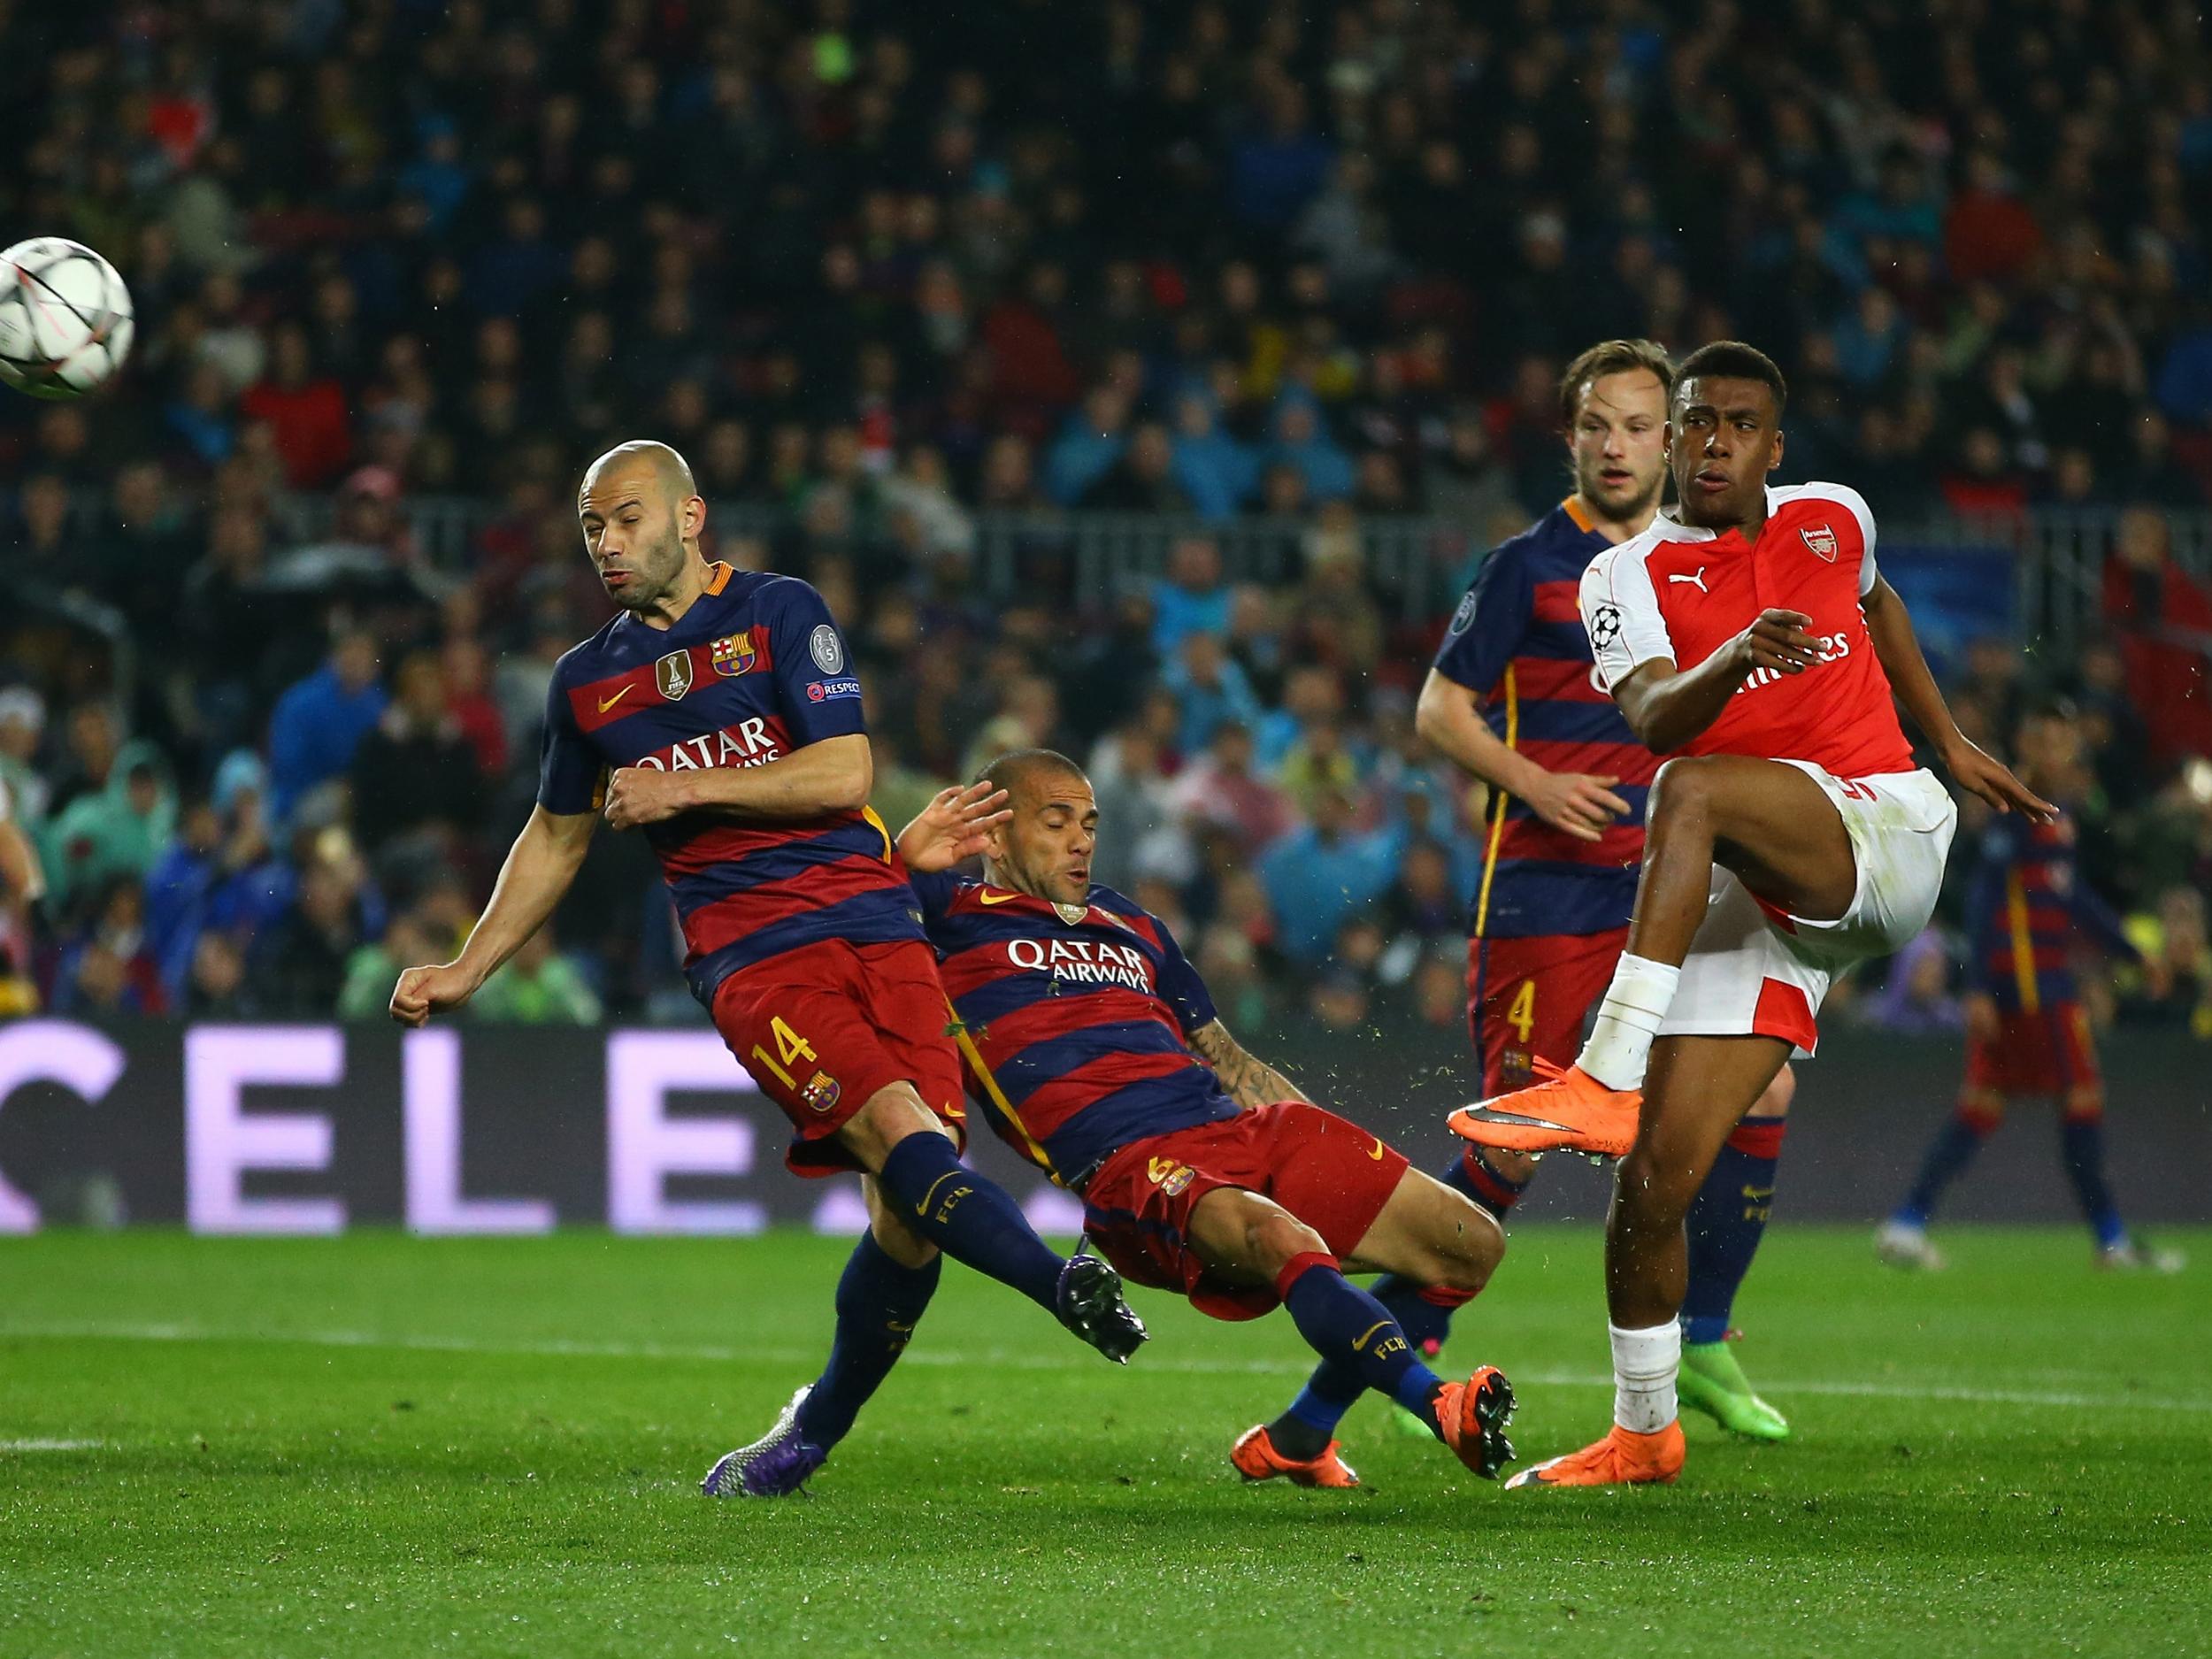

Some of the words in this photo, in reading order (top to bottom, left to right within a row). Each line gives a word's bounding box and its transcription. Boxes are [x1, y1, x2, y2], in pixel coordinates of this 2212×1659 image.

[826, 648, 834, 662] 5
[668, 680, 685, 691] FIFA
[824, 682, 861, 695] RESPEC
[1008, 939, 1146, 976] QATAR
[1054, 961, 1149, 995] AIRWAYS
[1508, 980, 1535, 1043] 4
[751, 1016, 818, 1091] 14
[1373, 1337, 1407, 1360] FCB
